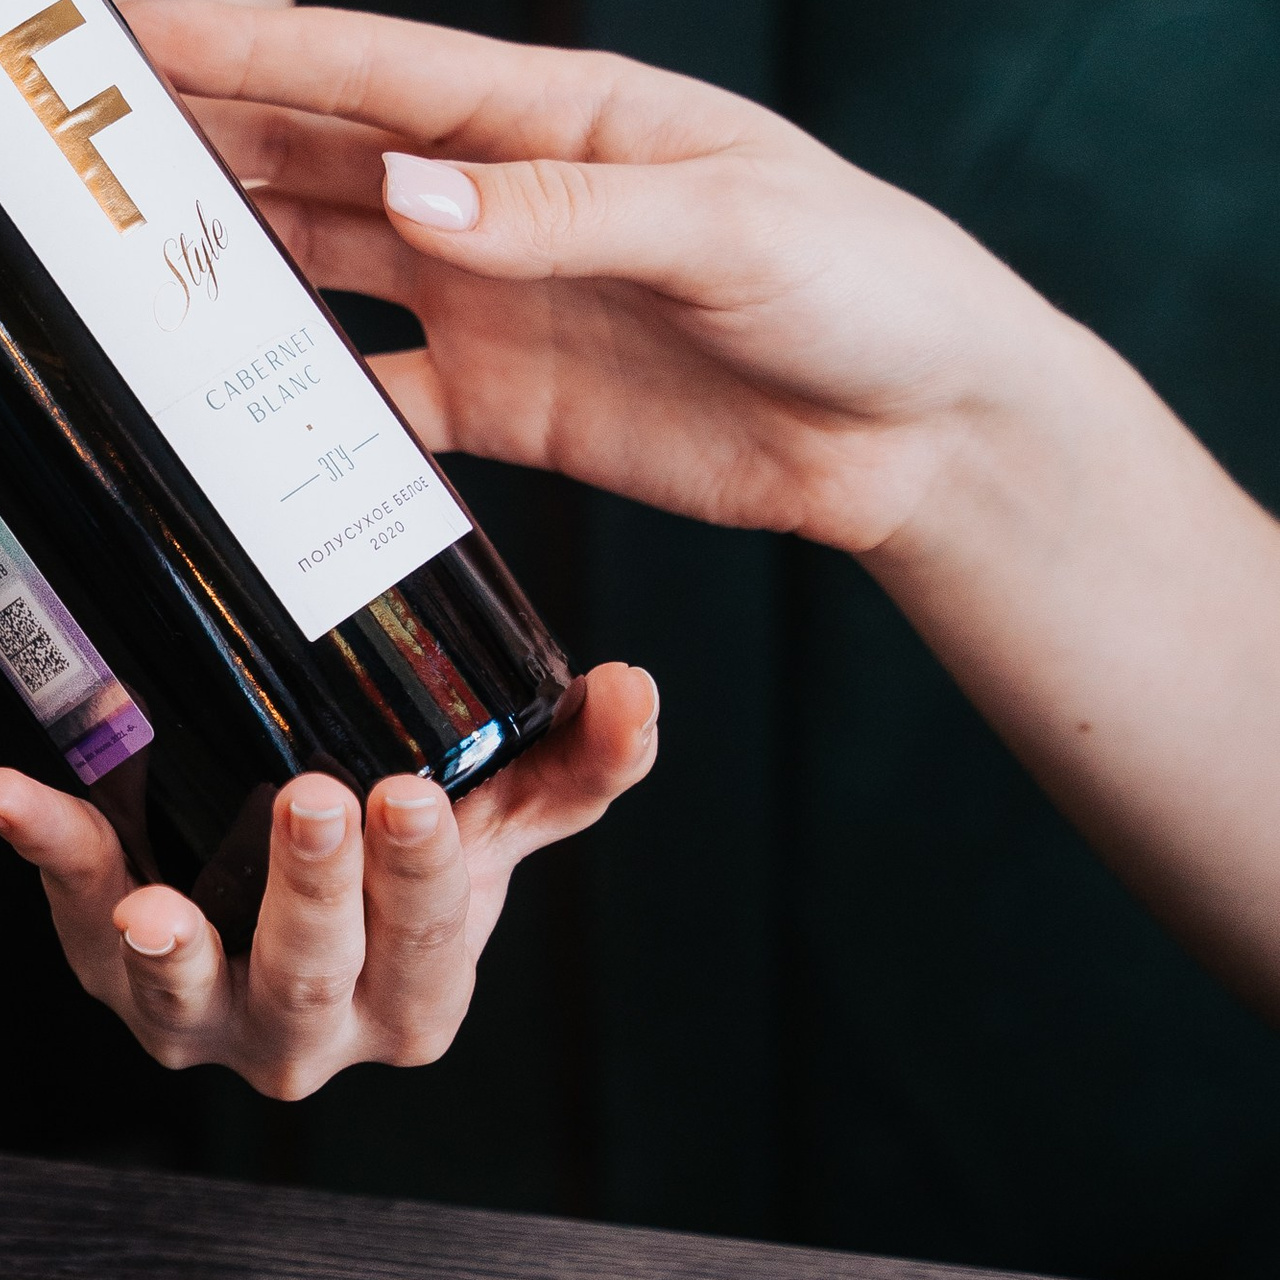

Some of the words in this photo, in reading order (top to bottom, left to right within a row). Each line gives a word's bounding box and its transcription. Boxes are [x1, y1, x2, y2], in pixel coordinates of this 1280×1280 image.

[153, 199, 229, 333] Style
[205, 326, 316, 411] CABERNET
[246, 363, 322, 424] BLANC
[317, 444, 356, 483] ЗГУ
[297, 500, 394, 573] ПОЛУСУХОЕ
[394, 475, 430, 508] БЕЛОЕ
[369, 520, 406, 552] 2020
